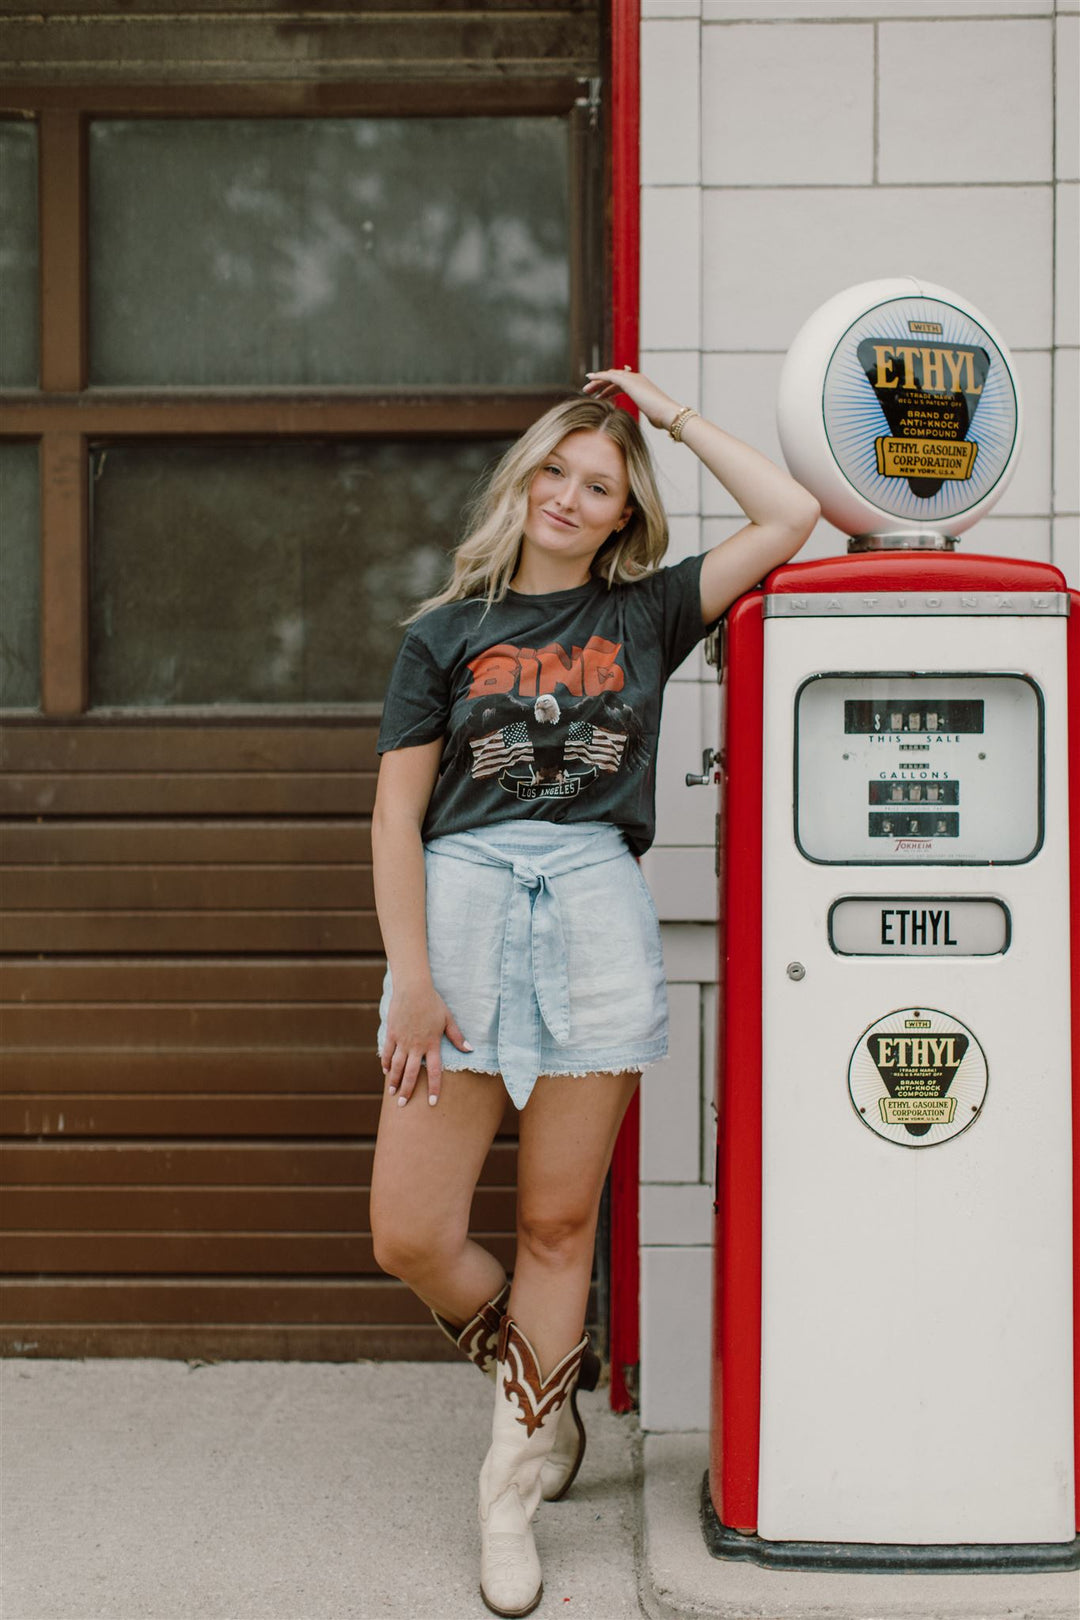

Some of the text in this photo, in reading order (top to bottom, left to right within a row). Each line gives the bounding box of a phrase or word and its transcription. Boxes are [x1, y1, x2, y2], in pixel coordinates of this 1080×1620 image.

[913, 323, 940, 332] WITH
[873, 345, 983, 395] ETHYL
[907, 410, 940, 419] BRAND
[900, 418, 960, 429] ANTI-KNOCK
[903, 427, 957, 438] COMPOUND
[888, 442, 968, 457] ETHYL GASOLINE
[893, 455, 963, 469] CORPORATION
[790, 598, 1050, 610] NATIONAL
[868, 735, 961, 743] THIS SALE
[879, 771, 949, 779] GALLONS
[521, 782, 575, 798] LOS ANGELES
[881, 909, 957, 945] ETHYL
[877, 1037, 961, 1067] ETHYL
[888, 1101, 949, 1109] ETHYL GASOLINE
[892, 1109, 945, 1117] CORPORATION
